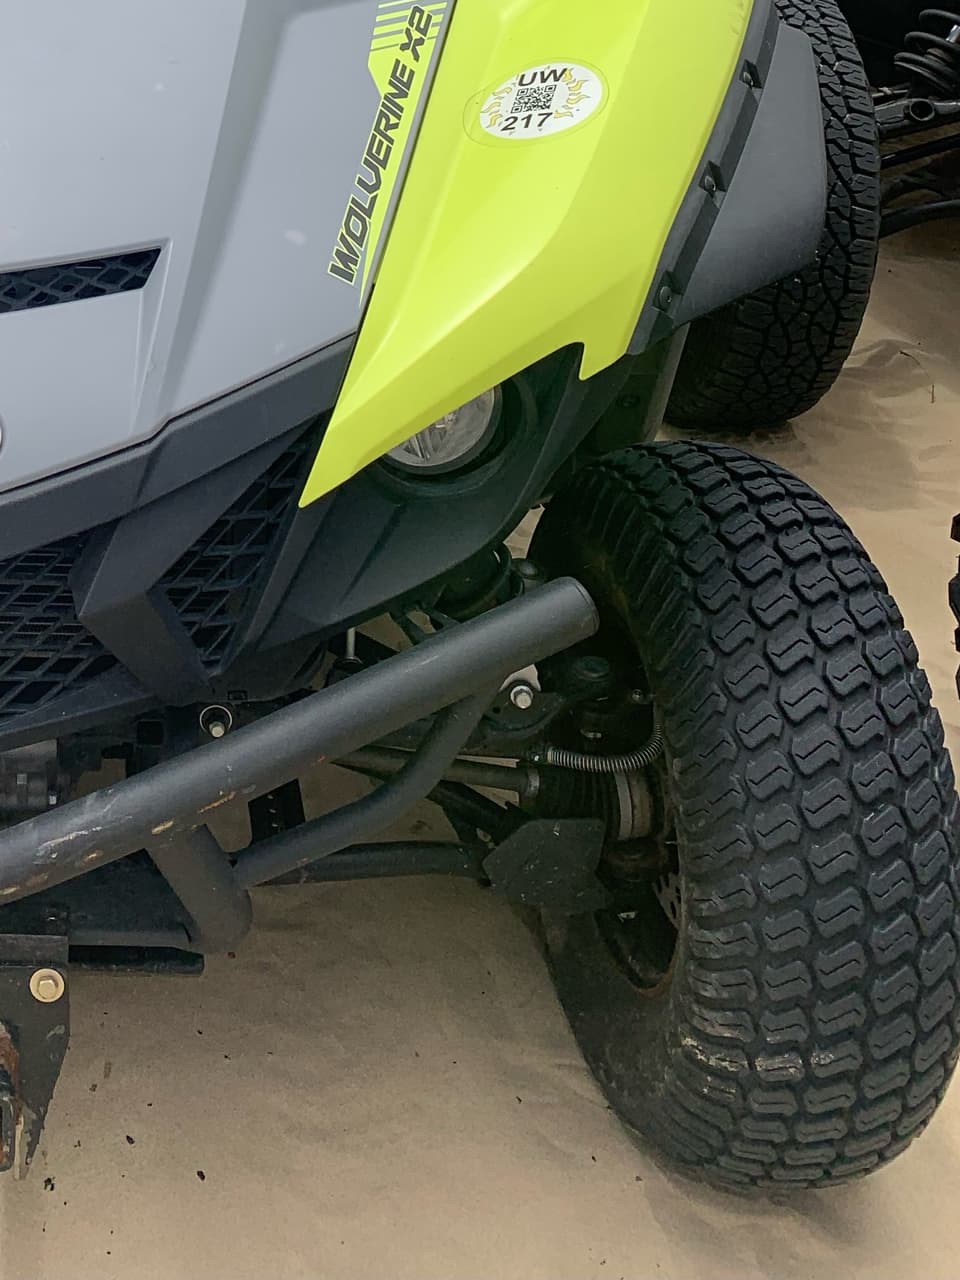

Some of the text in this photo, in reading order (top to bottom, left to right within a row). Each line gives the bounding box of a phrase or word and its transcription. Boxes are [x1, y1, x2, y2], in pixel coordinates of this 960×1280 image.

[517, 67, 568, 87] UW
[500, 112, 554, 132] 217
[327, 4, 434, 285] WOLVERINE X2
